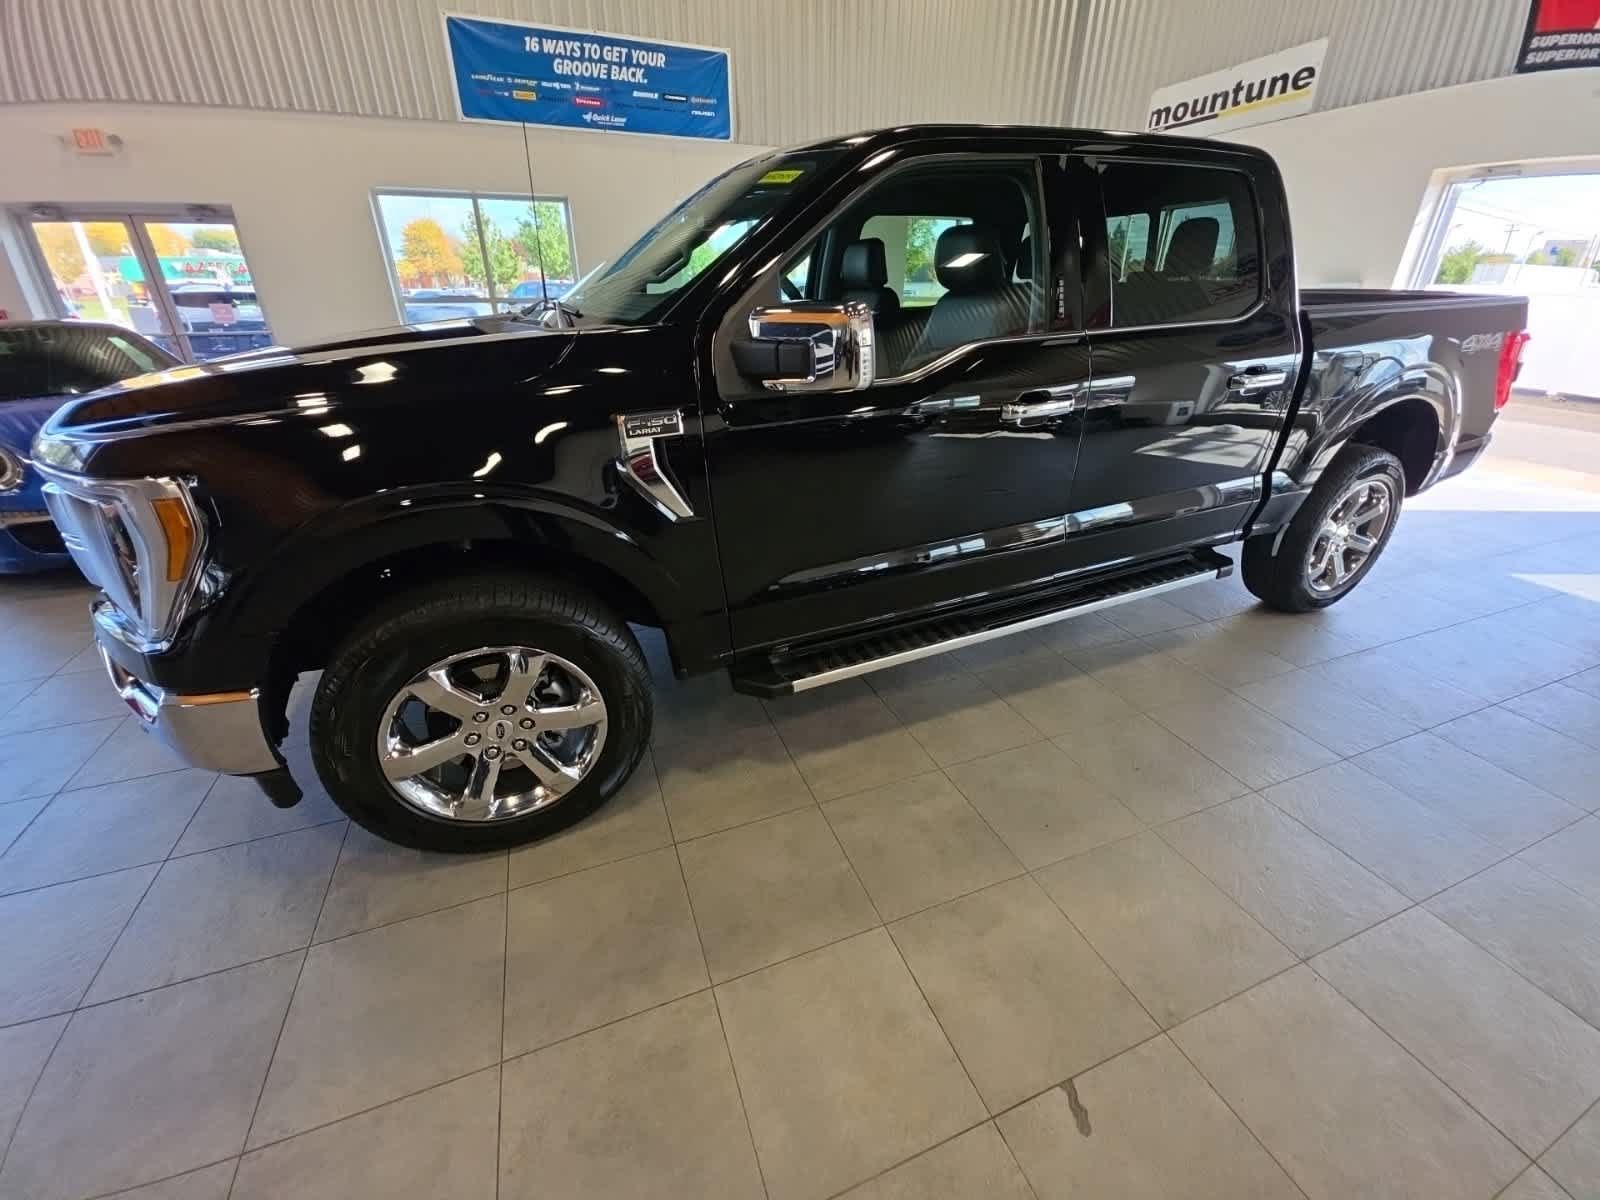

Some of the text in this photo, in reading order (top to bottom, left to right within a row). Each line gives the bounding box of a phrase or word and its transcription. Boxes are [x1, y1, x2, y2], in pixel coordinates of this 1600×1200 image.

[1529, 32, 1600, 49] SUPERIOR
[524, 36, 666, 68] 16 WAYS TO GET YOUR
[1524, 48, 1600, 65] SUPERIOR
[553, 58, 648, 84] GROOVE BACK.
[1148, 65, 1316, 129] mountune
[626, 414, 678, 429] F-150
[628, 426, 663, 437] LARIAT
